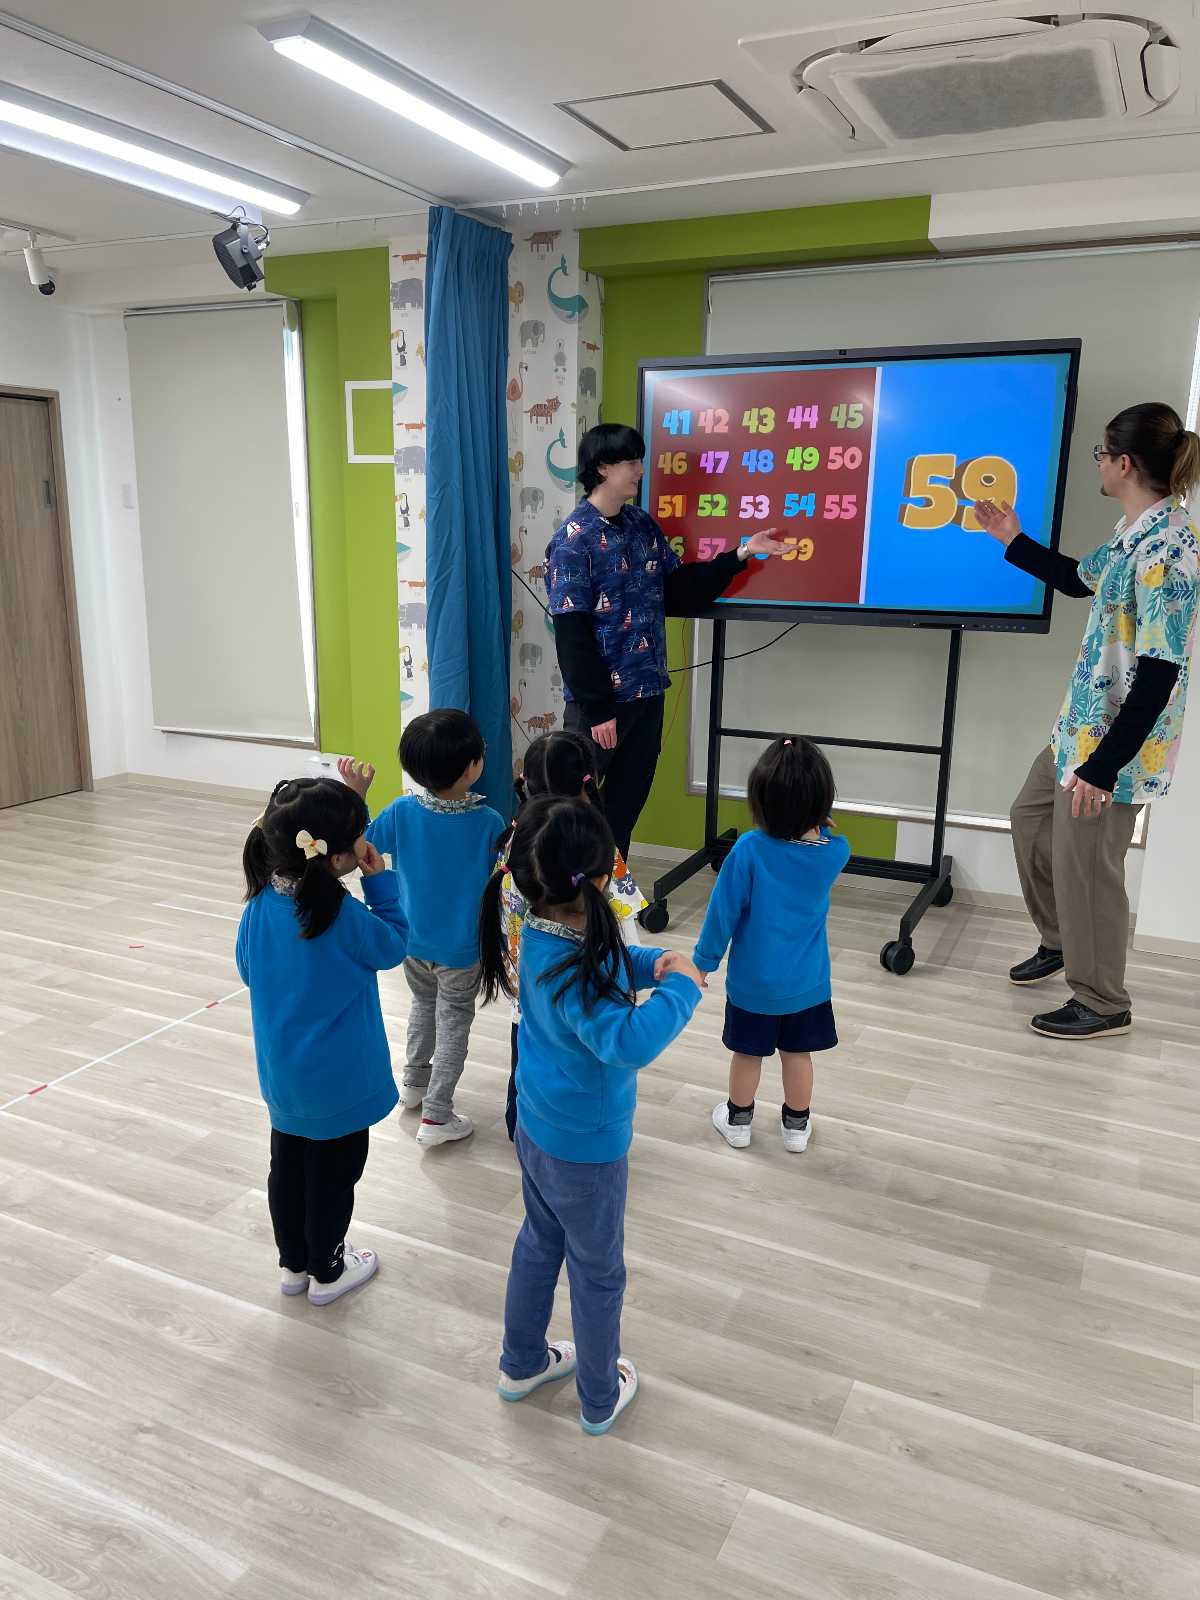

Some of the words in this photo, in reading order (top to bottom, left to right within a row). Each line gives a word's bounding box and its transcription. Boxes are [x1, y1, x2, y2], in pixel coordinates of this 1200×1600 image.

[662, 410, 692, 435] 41
[697, 409, 729, 434] 42
[742, 407, 776, 433] 43
[787, 405, 819, 429] 44
[830, 403, 864, 429] 45
[658, 452, 688, 475] 46
[700, 451, 729, 474] 47
[741, 449, 775, 473] 48
[786, 447, 820, 471] 49
[827, 447, 862, 470] 50
[657, 495, 686, 518] 51
[697, 494, 729, 517] 52
[738, 495, 770, 519] 53
[783, 493, 816, 517] 54
[823, 495, 857, 519] 55
[900, 453, 1017, 532] 59
[665, 536, 685, 558] 6
[697, 538, 727, 560] 57
[782, 537, 815, 561] 59
